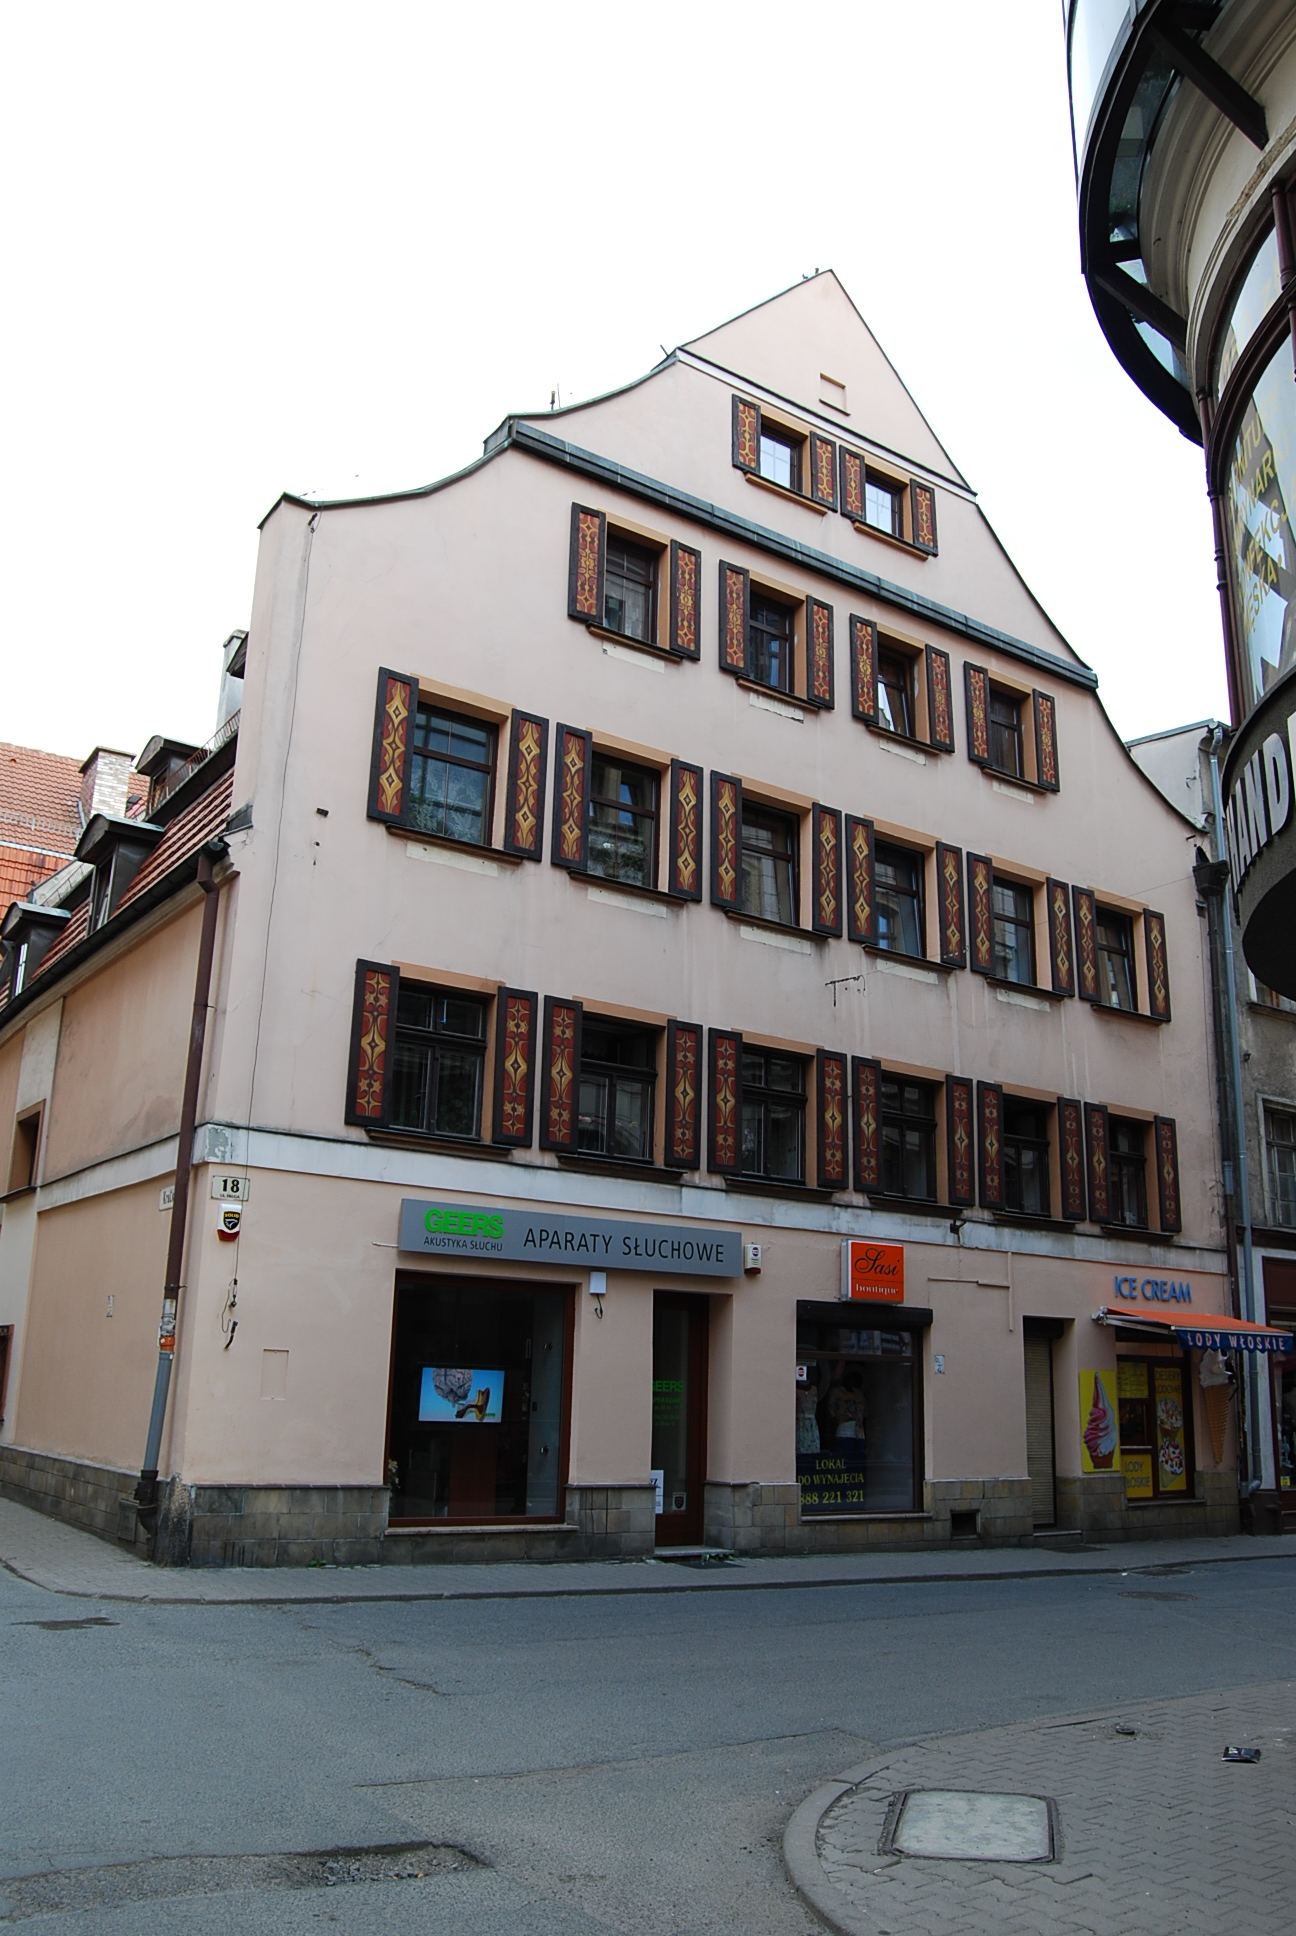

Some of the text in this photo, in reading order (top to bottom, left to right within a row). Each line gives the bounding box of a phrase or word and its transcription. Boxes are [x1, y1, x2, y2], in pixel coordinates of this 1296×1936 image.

[1226, 711, 1296, 893] HAND
[222, 1178, 240, 1193] 18
[425, 1207, 504, 1239] GEERS
[424, 1236, 503, 1252] AKUSTYKA SŁUCHU
[523, 1227, 613, 1255] APARATY
[622, 1235, 725, 1263] SŁUCHOWE
[854, 1247, 900, 1276] Sasi
[856, 1283, 899, 1296] boutique
[1114, 1276, 1192, 1303] ICE CREAM
[1228, 1335, 1286, 1351] WŁOSKIE
[815, 1458, 847, 1470] LOKAL
[798, 1474, 812, 1486] DO
[822, 1490, 842, 1504] 221
[845, 1489, 865, 1503] 321
